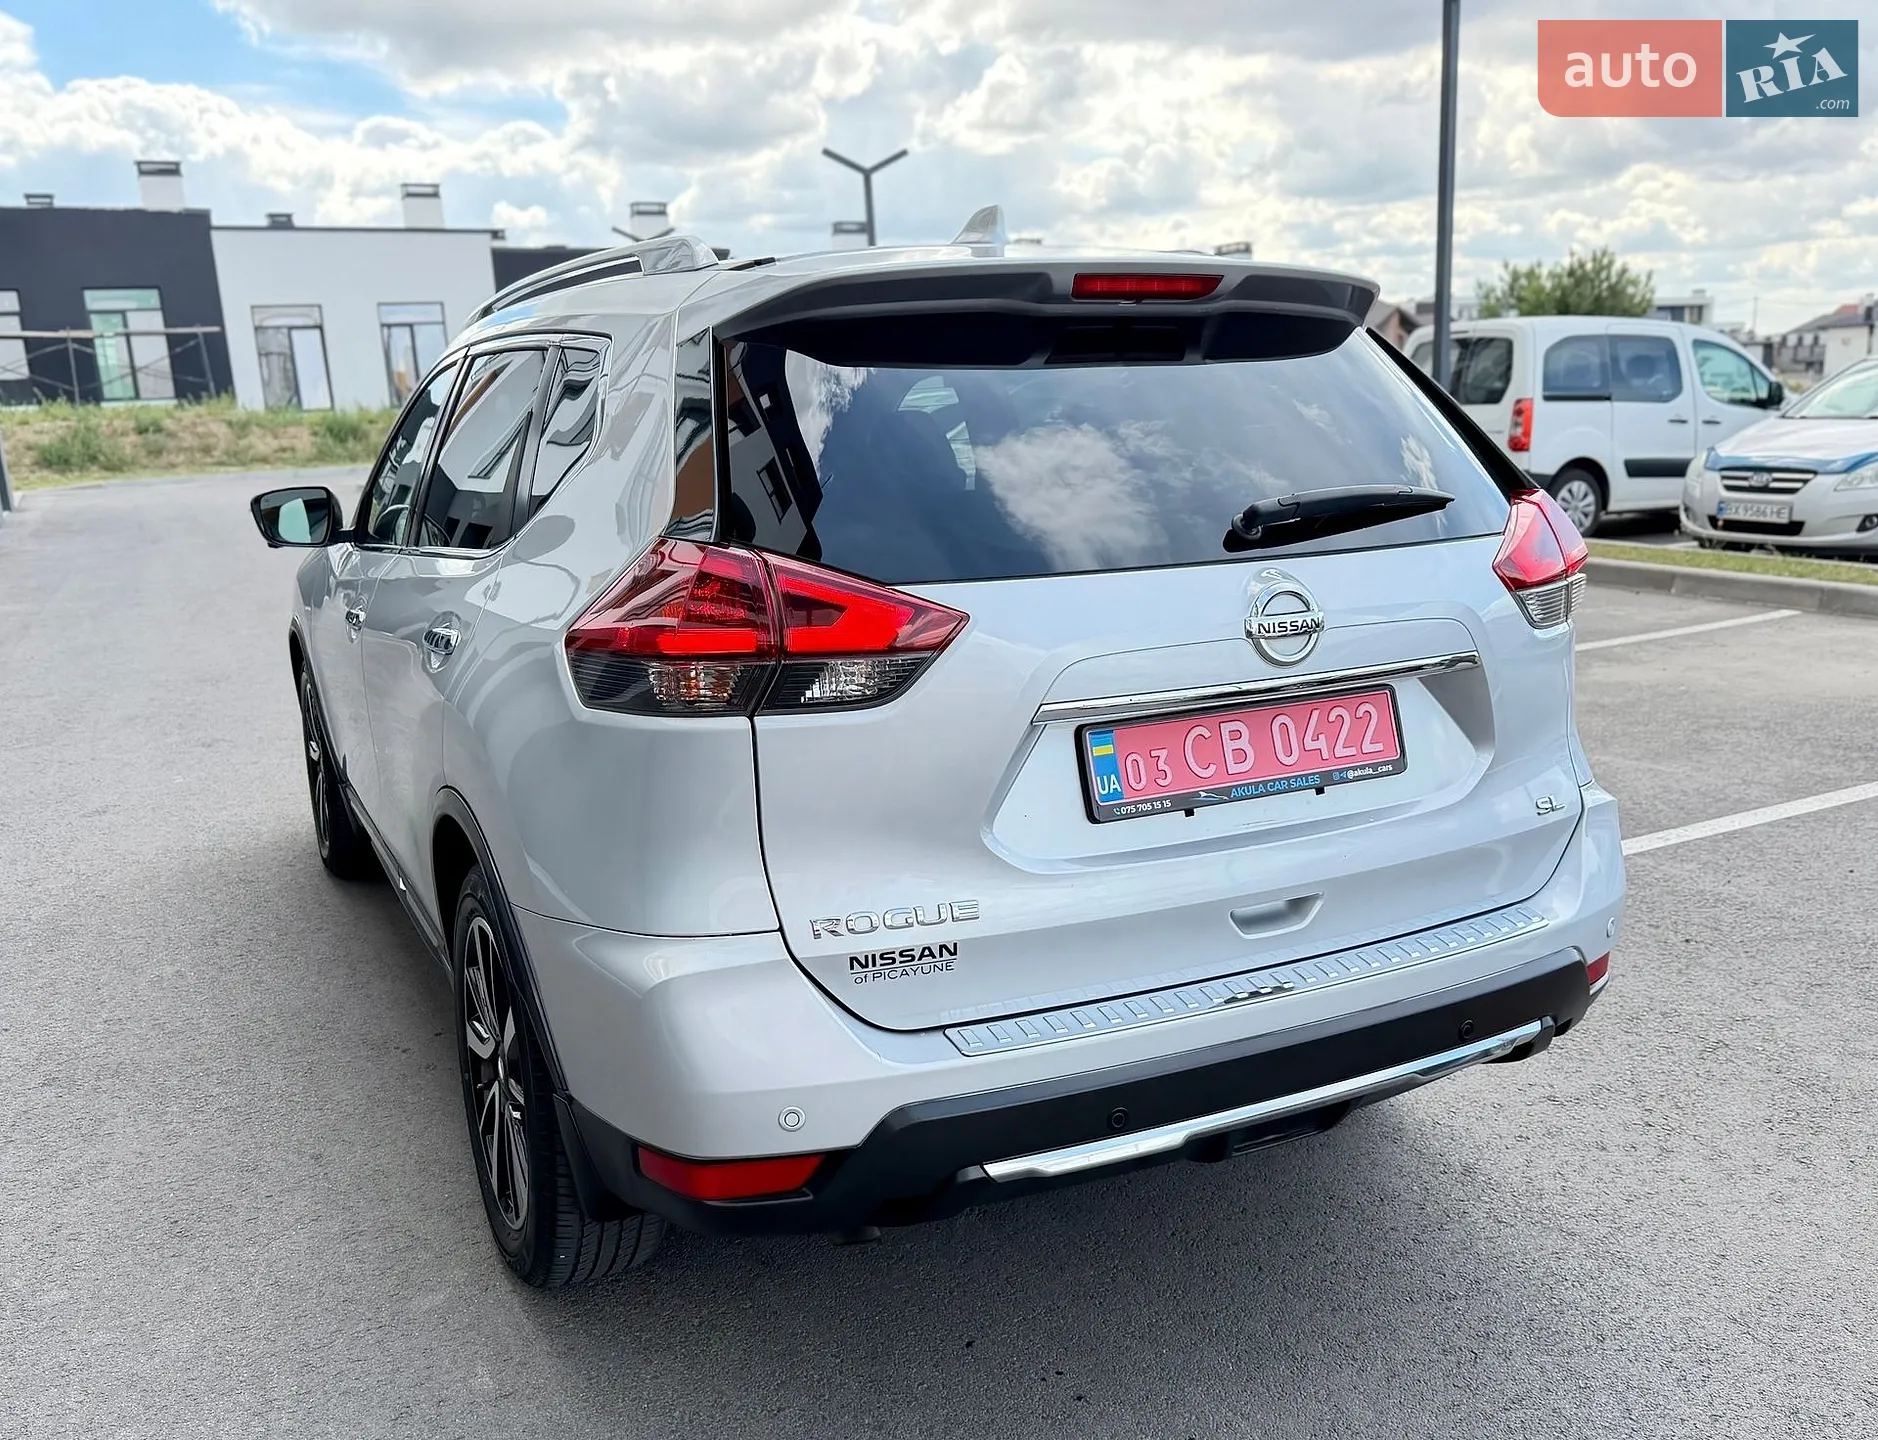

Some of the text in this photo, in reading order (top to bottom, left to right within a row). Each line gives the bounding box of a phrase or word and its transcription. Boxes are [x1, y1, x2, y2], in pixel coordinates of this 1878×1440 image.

[1258, 617, 1320, 634] NISSAN
[1124, 700, 1384, 791] 03 CB 0422
[1097, 772, 1122, 795] UA
[1231, 775, 1320, 798] AKULA CAR SALES
[1121, 799, 1171, 815] 075 705 15 15
[1535, 796, 1566, 816] SL
[809, 899, 981, 940] ROGUE
[849, 942, 958, 970] NISSAN
[854, 961, 955, 985] of PICAYUNE
